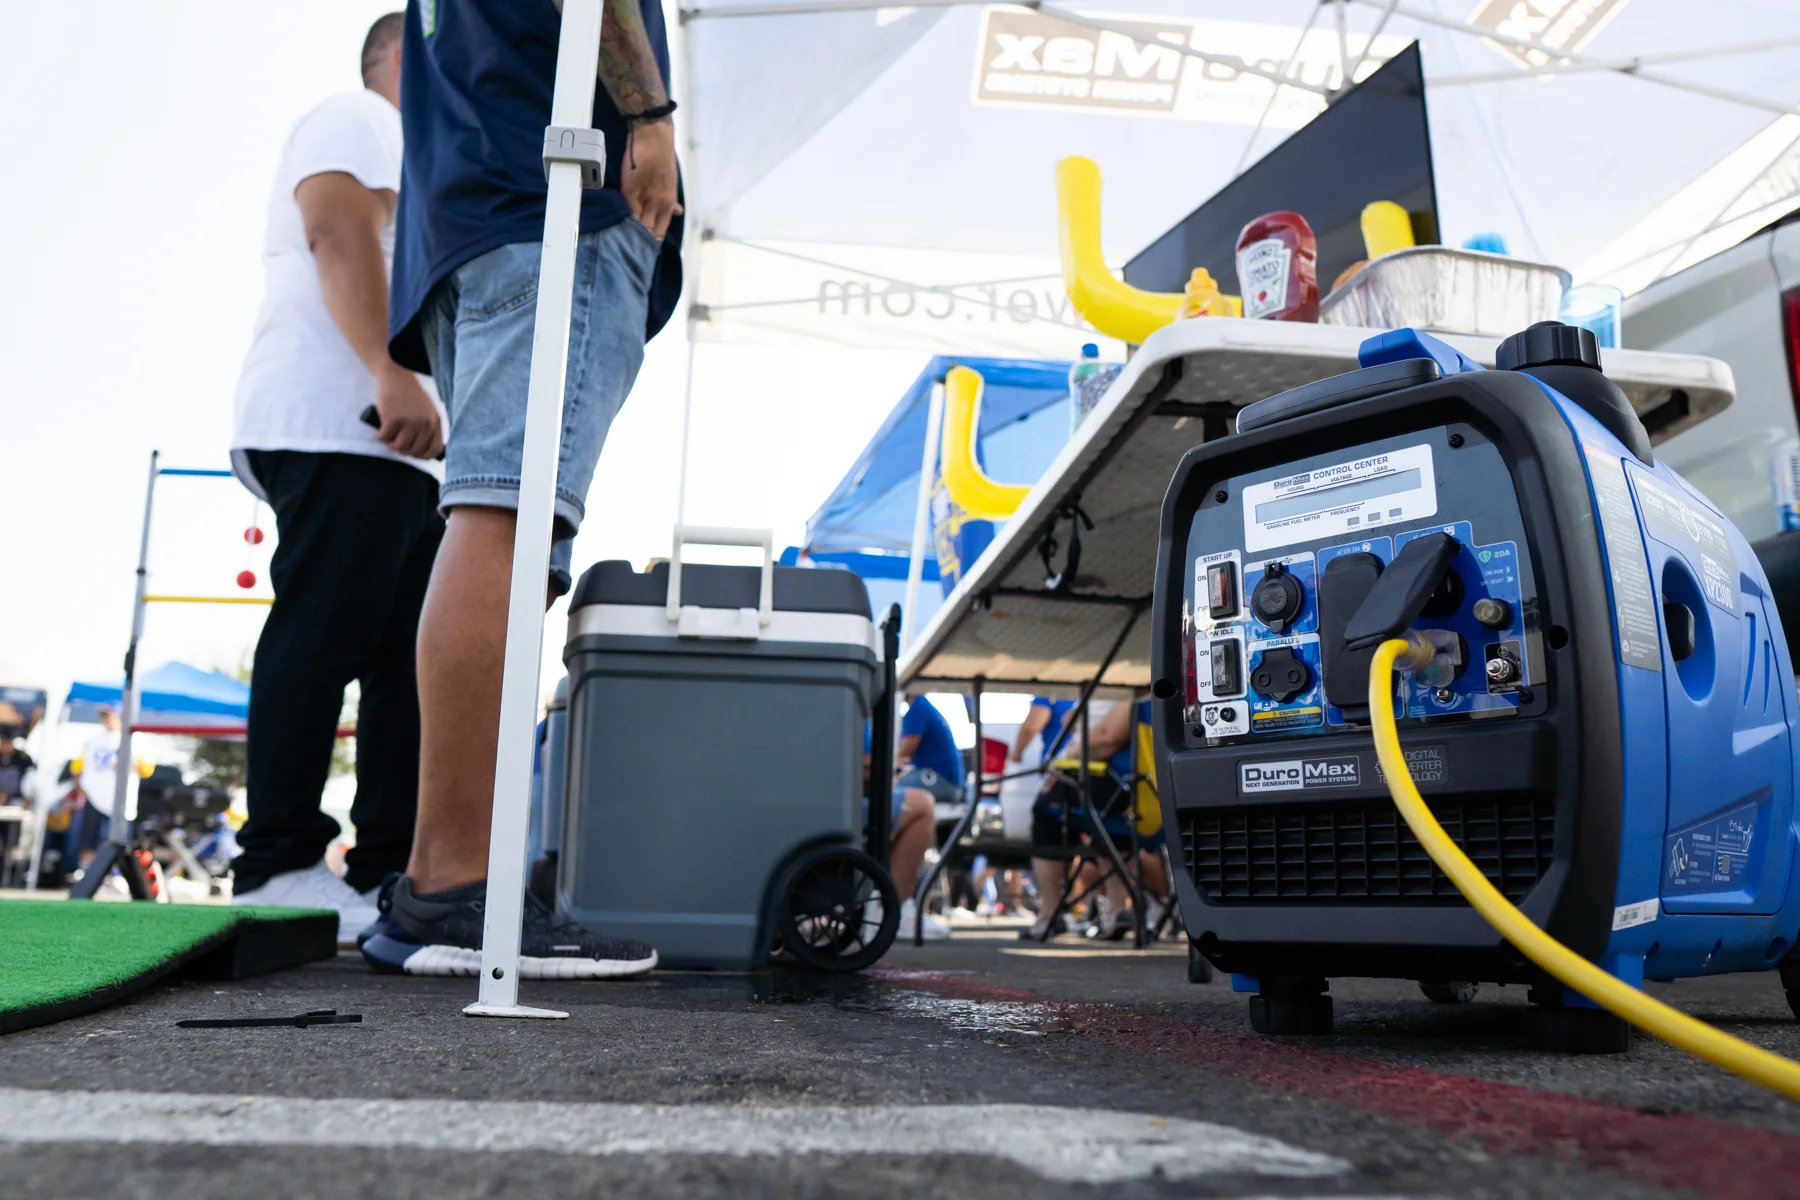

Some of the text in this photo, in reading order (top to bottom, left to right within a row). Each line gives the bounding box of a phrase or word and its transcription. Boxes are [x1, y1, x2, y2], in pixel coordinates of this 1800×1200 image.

[1313, 464, 1353, 480] CONTROL
[1354, 456, 1389, 470] CENTER
[1373, 465, 1389, 473] LOAD
[1330, 473, 1353, 483] VOLTAGE
[1287, 485, 1305, 493] HOURS
[1330, 506, 1361, 517] FREQUENCY
[1266, 514, 1321, 530] GASOLINE FUEL METER
[1494, 549, 1511, 558] 20A
[1203, 554, 1223, 563] START
[1220, 627, 1235, 636] IDLE
[1266, 637, 1300, 648] PARALLEL
[1278, 709, 1301, 717] CAUTION
[1404, 749, 1441, 761] DIGITAL
[1408, 759, 1442, 771] ERTER
[1261, 779, 1300, 787] GENERATION
[1328, 775, 1358, 783] SYSTEMS
